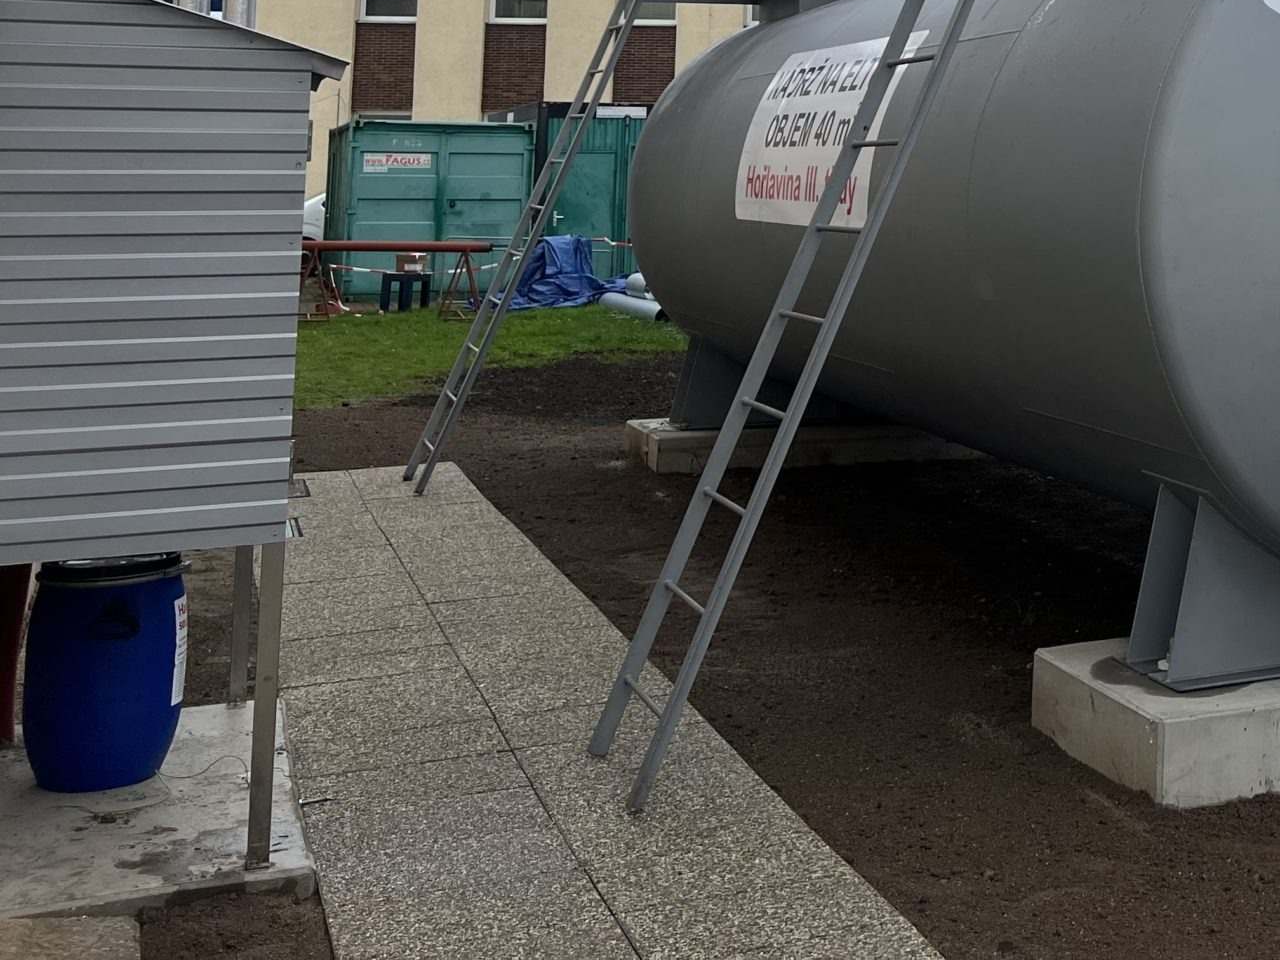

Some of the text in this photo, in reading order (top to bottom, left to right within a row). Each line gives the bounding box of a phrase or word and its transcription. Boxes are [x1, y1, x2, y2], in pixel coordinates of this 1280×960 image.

[814, 63, 847, 96] NA
[765, 112, 818, 148] OBJEM
[814, 110, 836, 148] 40
[745, 165, 801, 201] Hořlavina
[804, 165, 819, 202] III.
